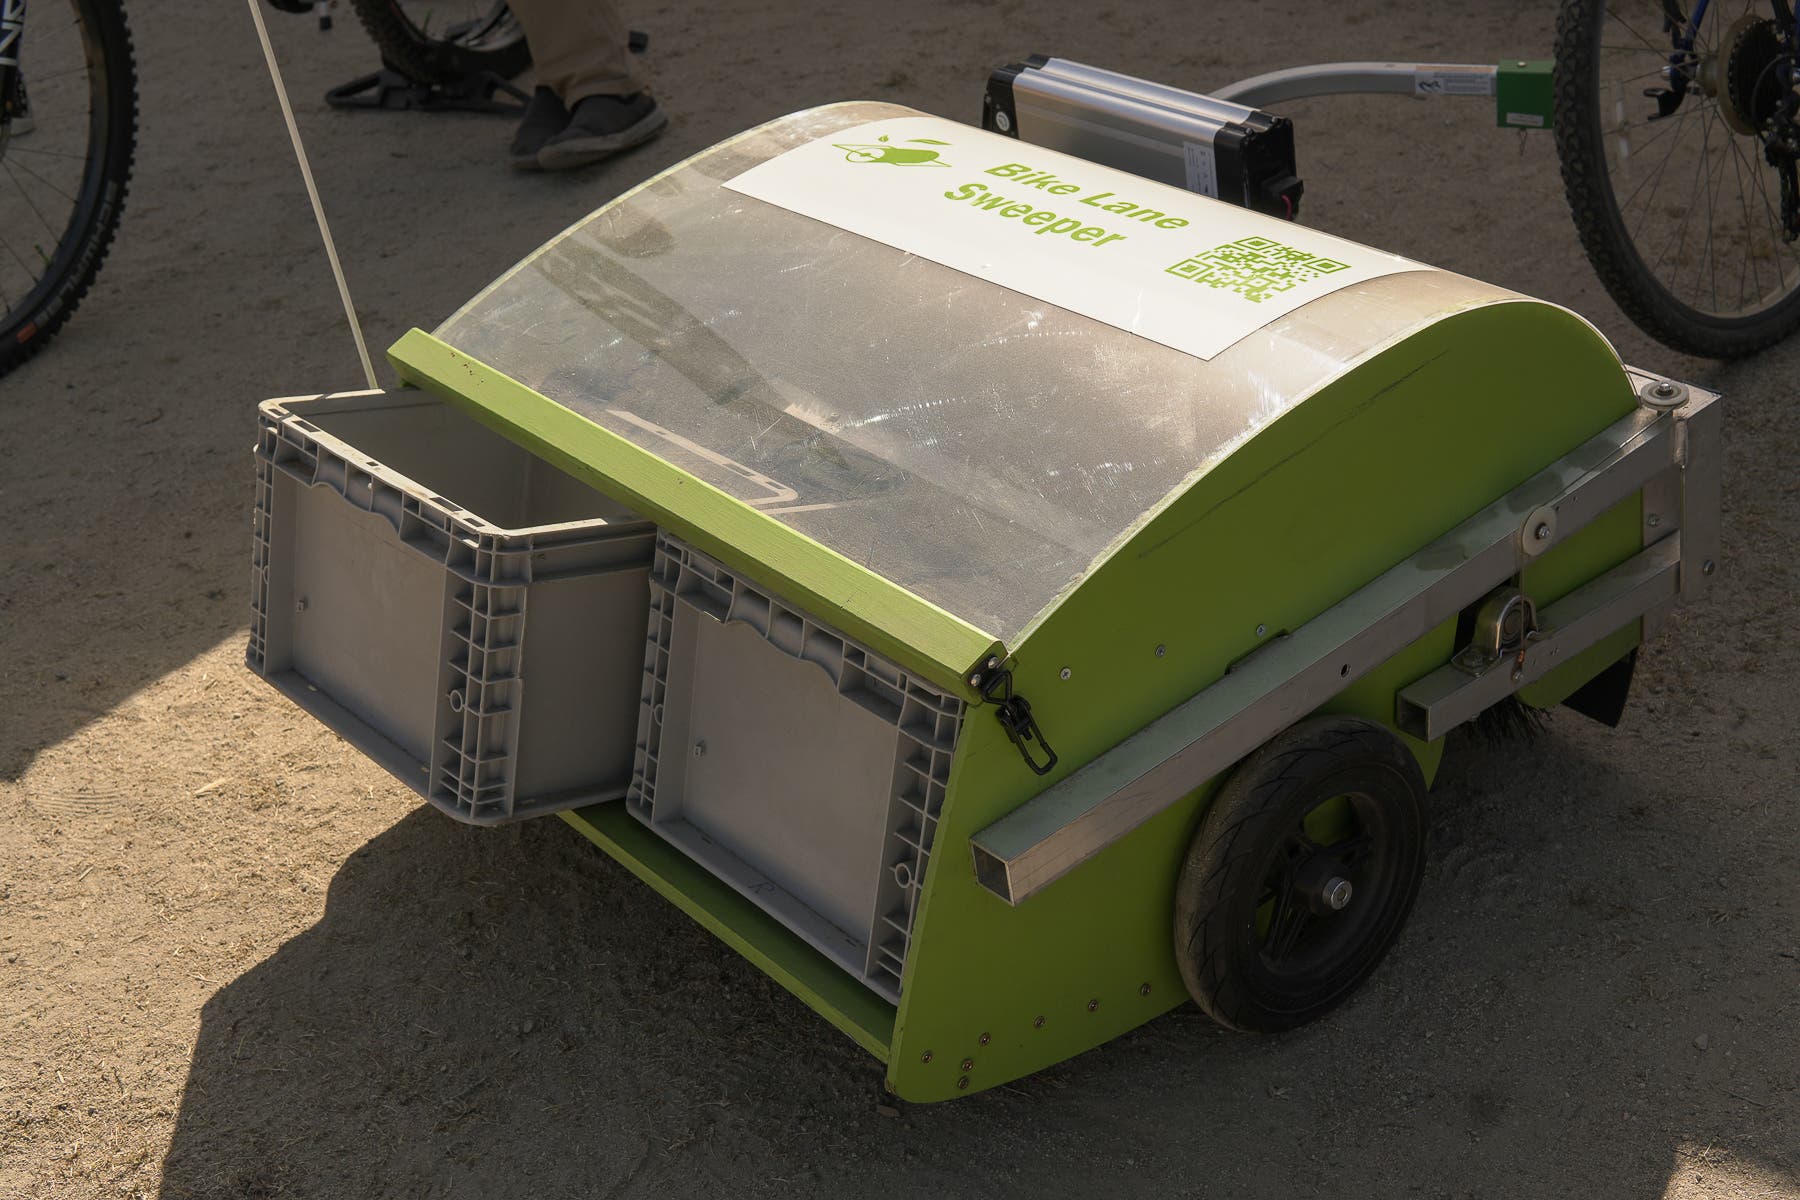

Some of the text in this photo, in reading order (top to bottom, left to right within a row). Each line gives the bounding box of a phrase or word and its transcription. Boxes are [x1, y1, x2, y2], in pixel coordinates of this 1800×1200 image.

[943, 182, 1128, 248] Sweeper
[983, 162, 1190, 230] Bike Lane
